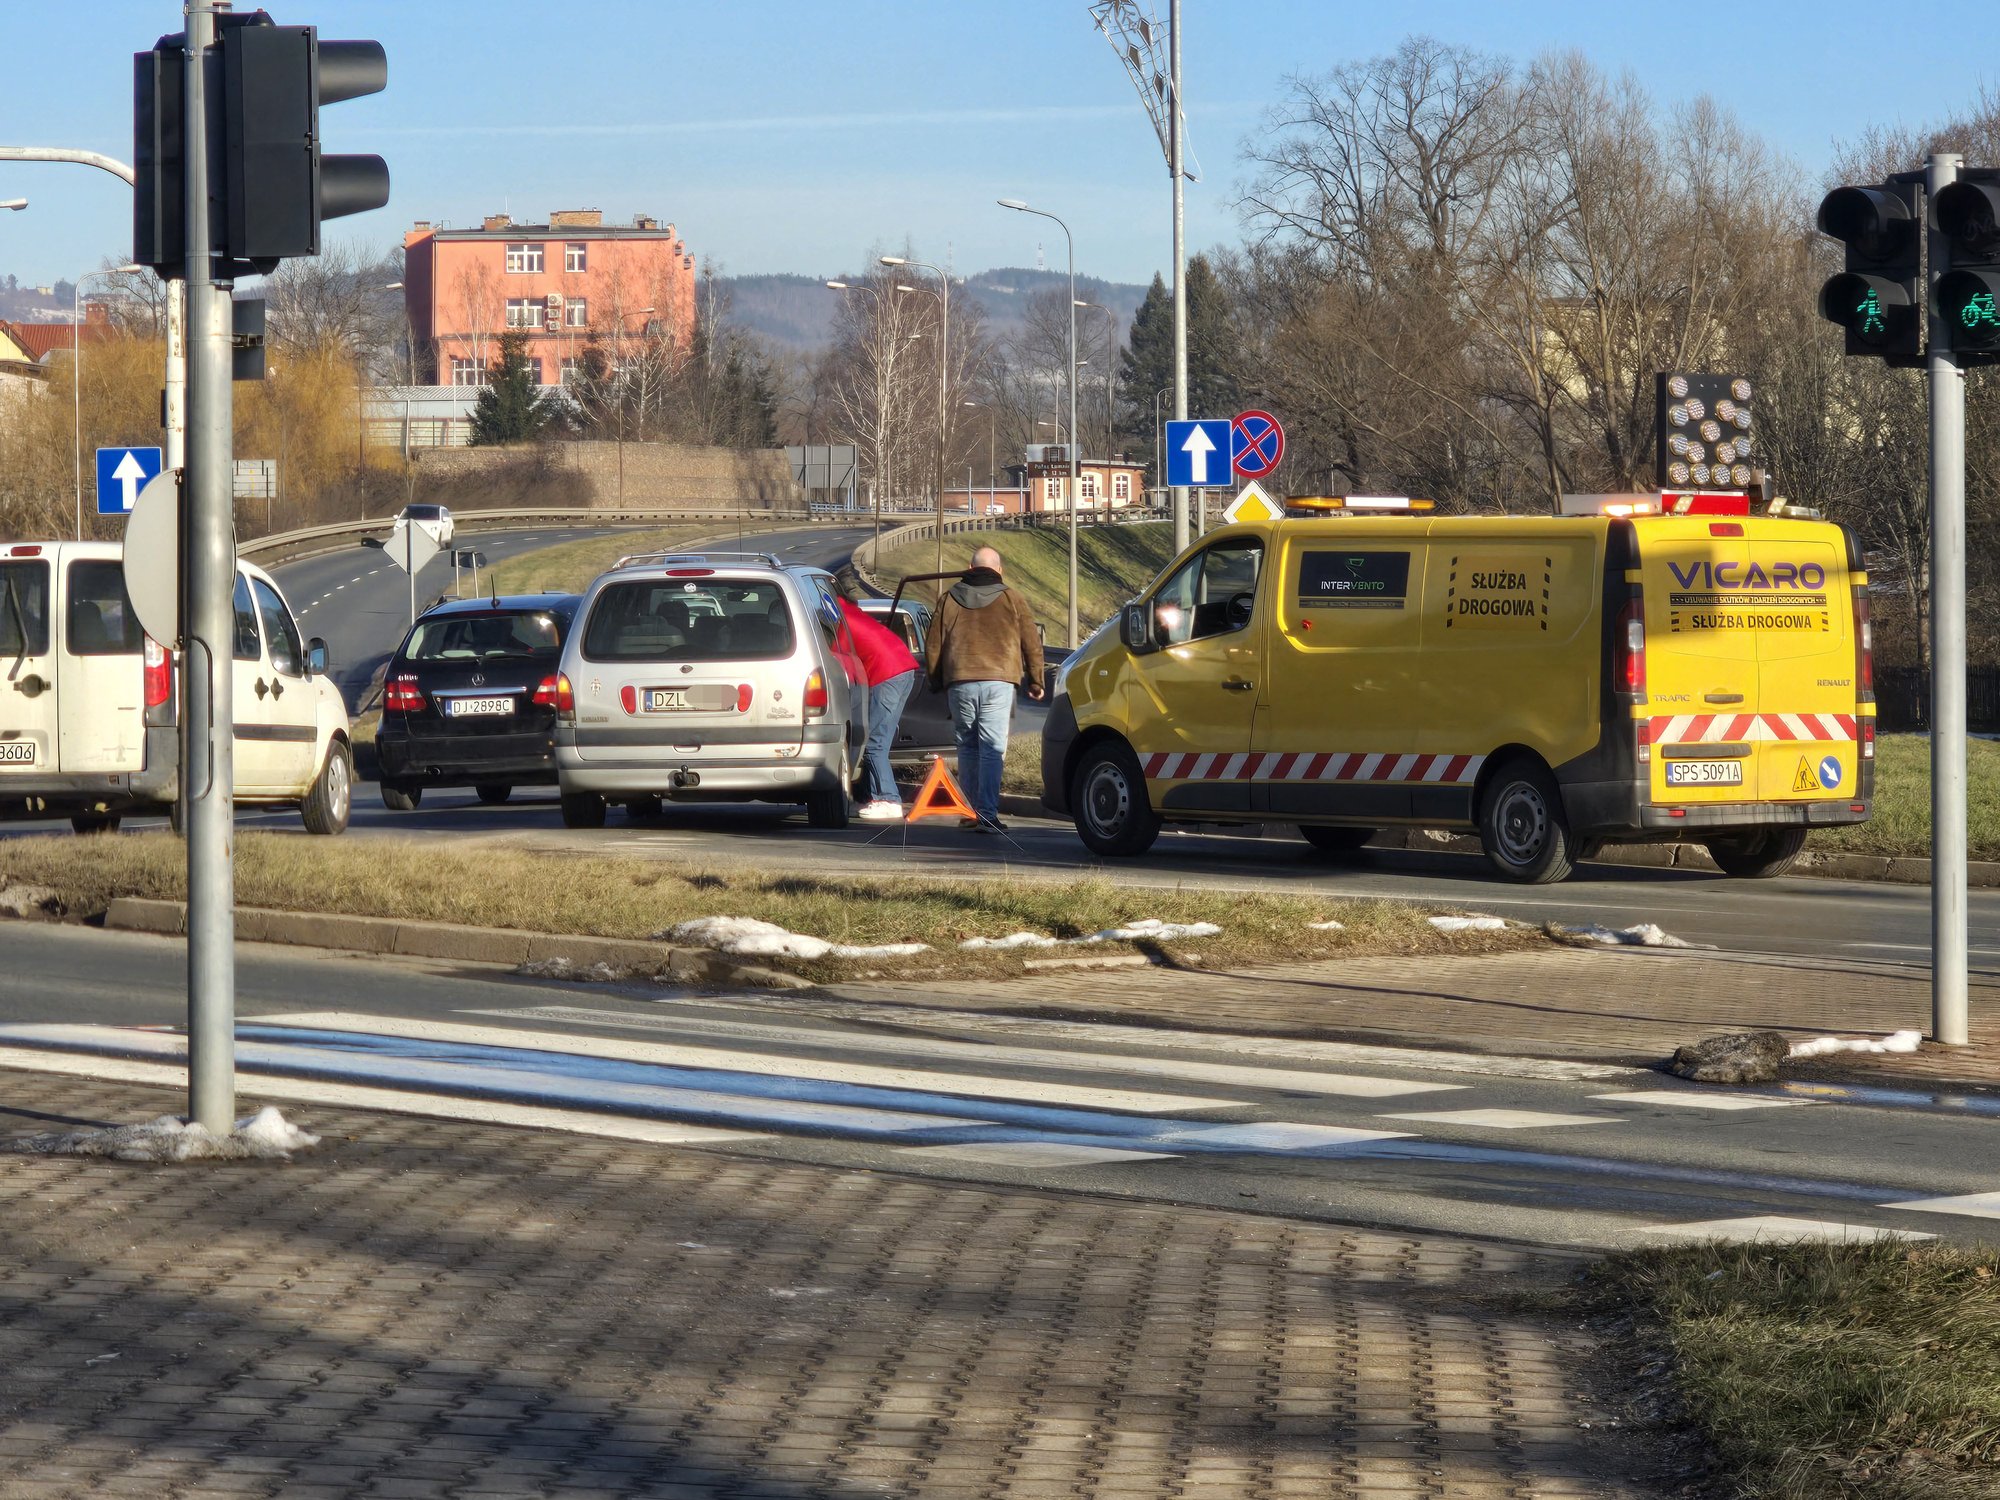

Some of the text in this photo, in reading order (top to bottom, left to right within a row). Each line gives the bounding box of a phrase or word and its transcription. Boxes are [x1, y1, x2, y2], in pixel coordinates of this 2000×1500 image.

[1471, 569, 1527, 590] SŁUŻBA
[1666, 561, 1825, 589] VICARO
[1321, 581, 1385, 590] INTERVENTO
[1459, 598, 1535, 616] DROGOWA
[1692, 611, 1812, 628] SŁUŻBA DROGOWA
[1816, 679, 1851, 687] RENAULT
[655, 692, 685, 707] DZL
[1674, 764, 1699, 781] SPS
